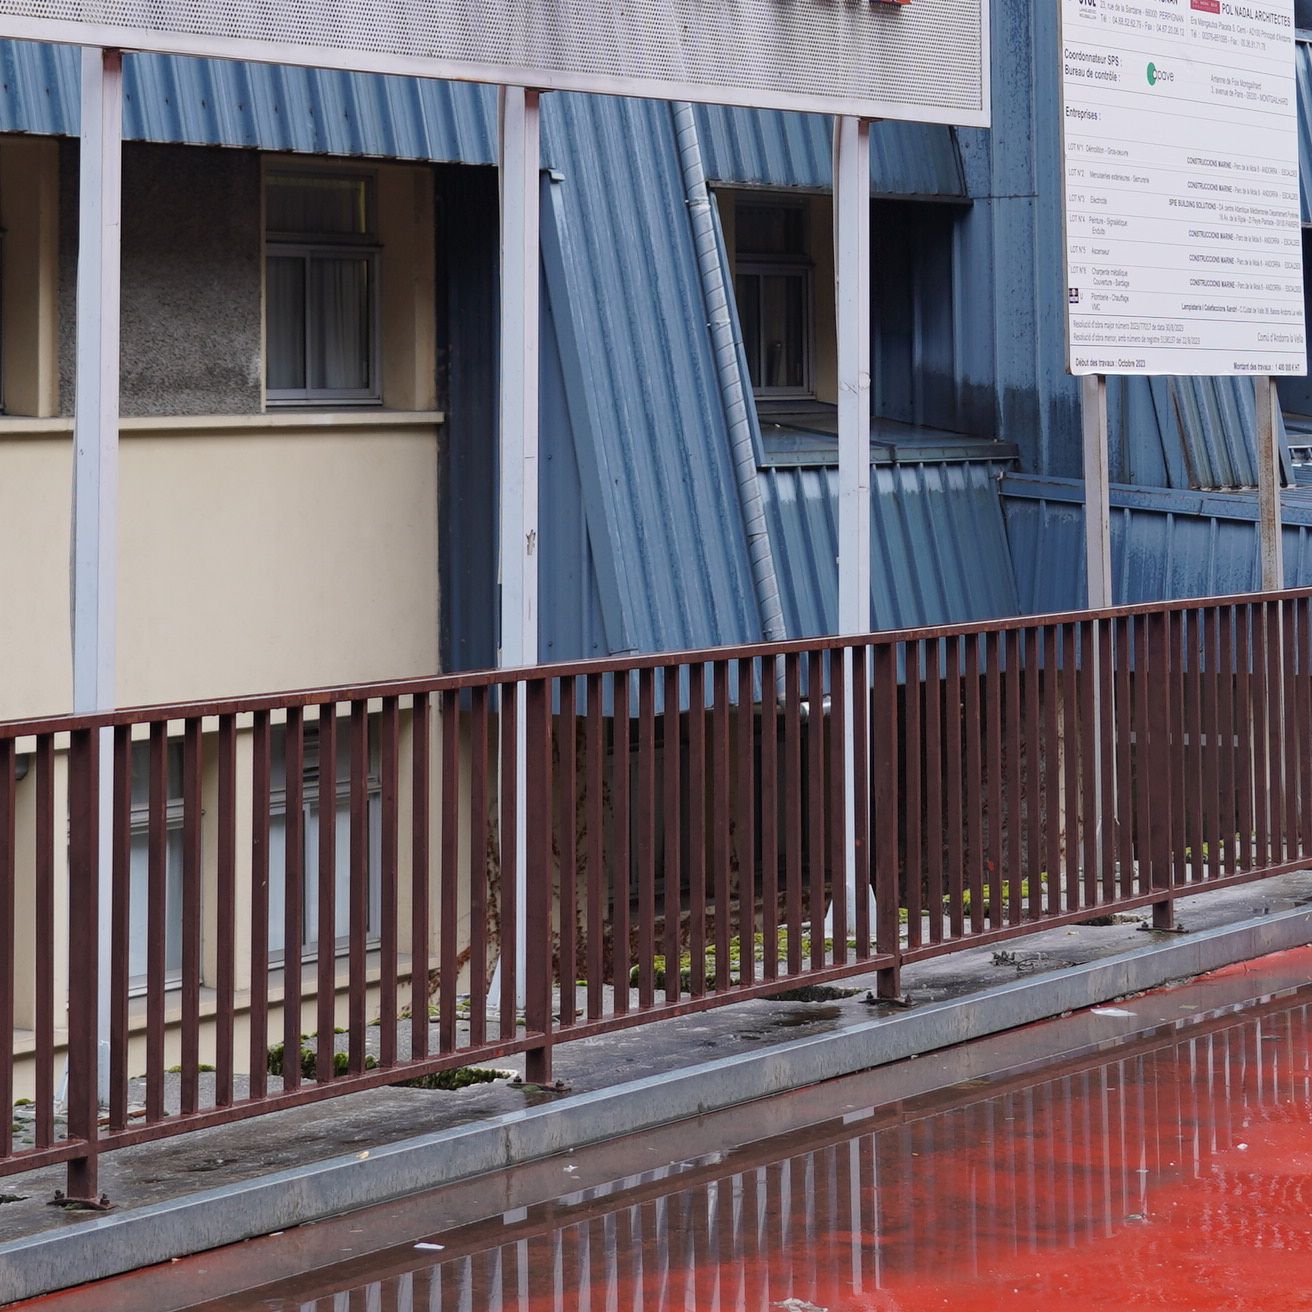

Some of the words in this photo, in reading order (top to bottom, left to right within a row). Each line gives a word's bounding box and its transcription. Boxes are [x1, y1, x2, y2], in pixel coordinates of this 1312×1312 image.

[1222, 3, 1233, 15] POL
[1234, 5, 1253, 19] NADAL
[1254, 9, 1290, 27] ARCHITECTES
[1064, 48, 1105, 64] Coordonnateur
[1107, 55, 1119, 66] SPS
[1064, 64, 1084, 77] Bureau
[1086, 67, 1093, 78] de
[1094, 69, 1117, 81] contrôle
[1065, 106, 1097, 121] Entreprises
